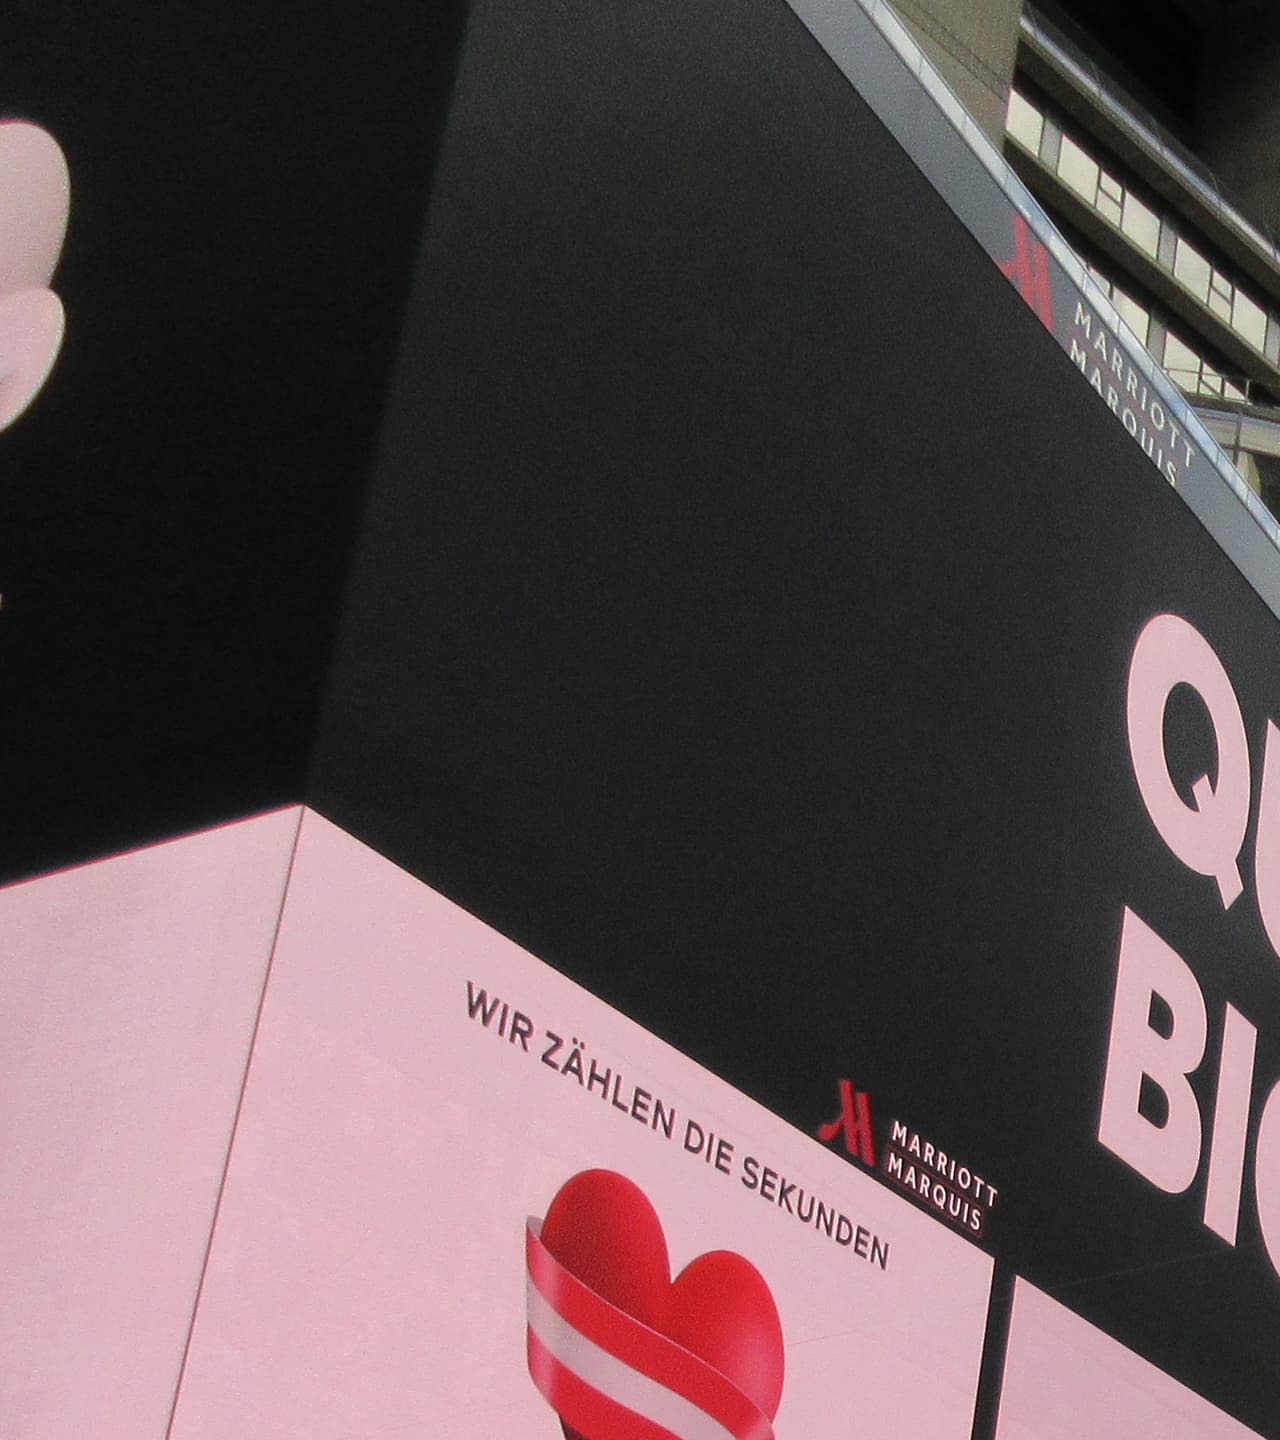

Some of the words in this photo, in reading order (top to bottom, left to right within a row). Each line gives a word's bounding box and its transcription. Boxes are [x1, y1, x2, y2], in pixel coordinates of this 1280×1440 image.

[1070, 339, 1178, 488] MARQUIS
[1074, 302, 1196, 470] MARRIOTT
[465, 980, 535, 1052] WIR
[540, 1030, 677, 1140] ZÄHLEN
[683, 1118, 735, 1177] DIE
[740, 1155, 890, 1271] SEKUNDEN
[887, 1151, 983, 1232] MARQUIS
[891, 1120, 999, 1207] MARRIOTT
